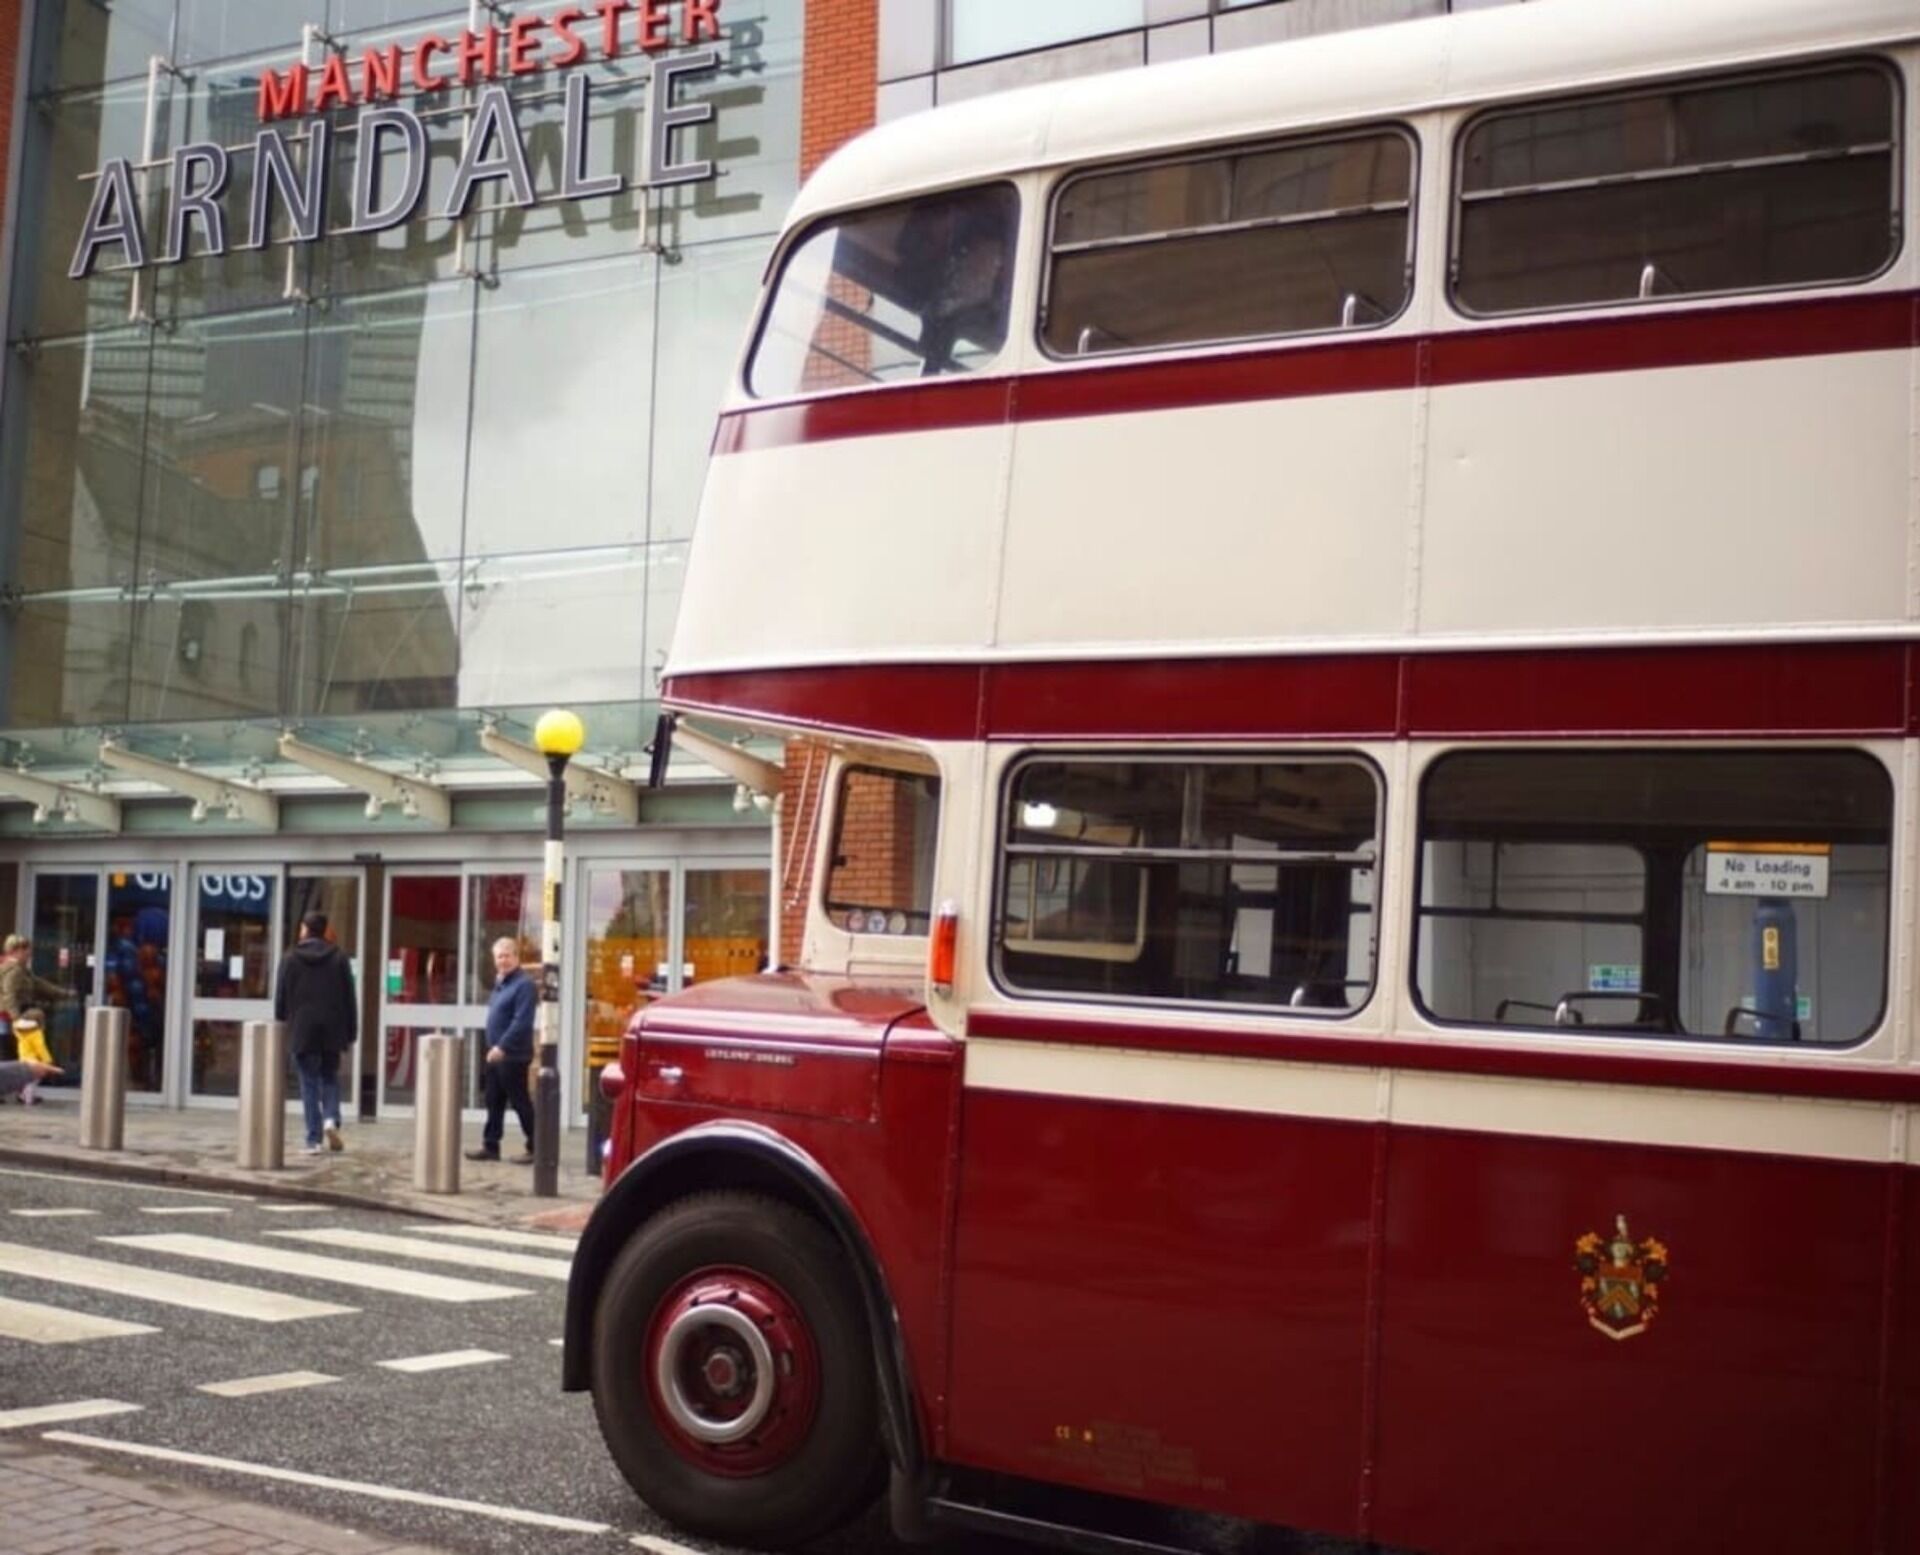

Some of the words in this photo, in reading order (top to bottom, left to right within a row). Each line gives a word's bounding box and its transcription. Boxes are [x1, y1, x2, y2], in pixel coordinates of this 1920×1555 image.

[257, 0, 723, 122] MANCHESTER
[68, 50, 720, 280] ARNDALE
[1724, 858, 1746, 873] No
[1755, 859, 1811, 878] Loading
[1791, 880, 1814, 893] pm
